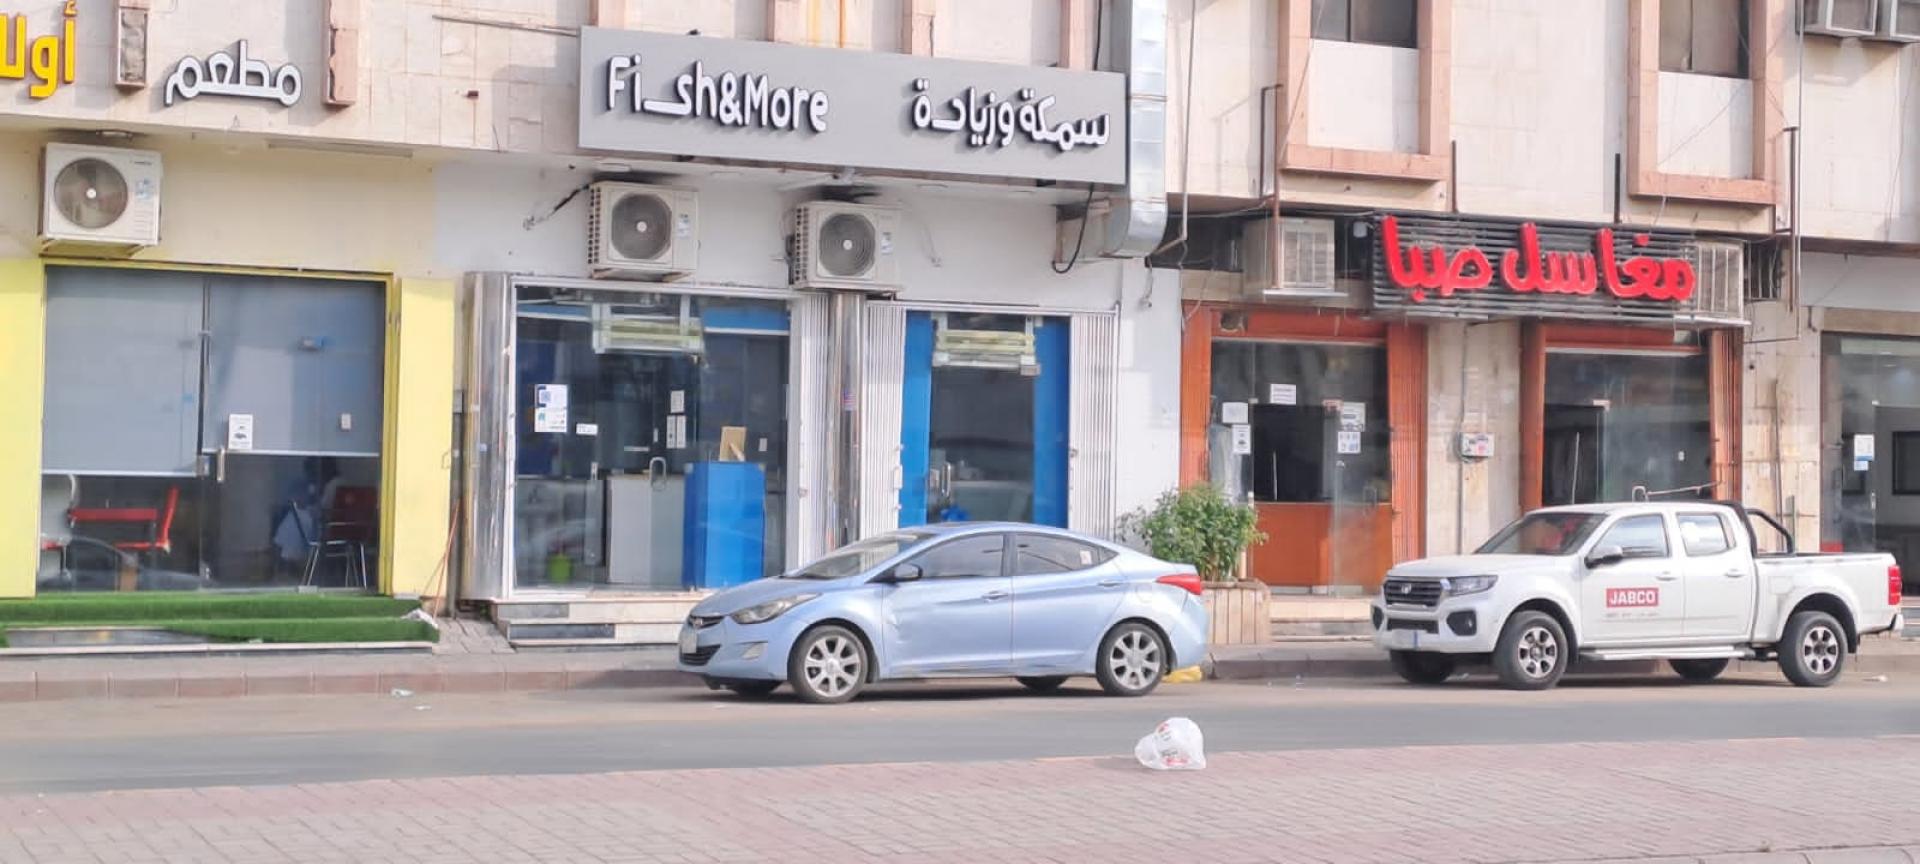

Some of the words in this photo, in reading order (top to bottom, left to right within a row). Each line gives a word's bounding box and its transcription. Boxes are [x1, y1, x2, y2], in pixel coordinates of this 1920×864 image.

[164, 39, 301, 106] مطعم
[912, 78, 1016, 146] وزيادة
[1018, 88, 1110, 151] سمكة
[1381, 214, 1493, 303] صبا
[1503, 222, 1697, 301] مغاسل
[1609, 590, 1657, 605] JABCO
